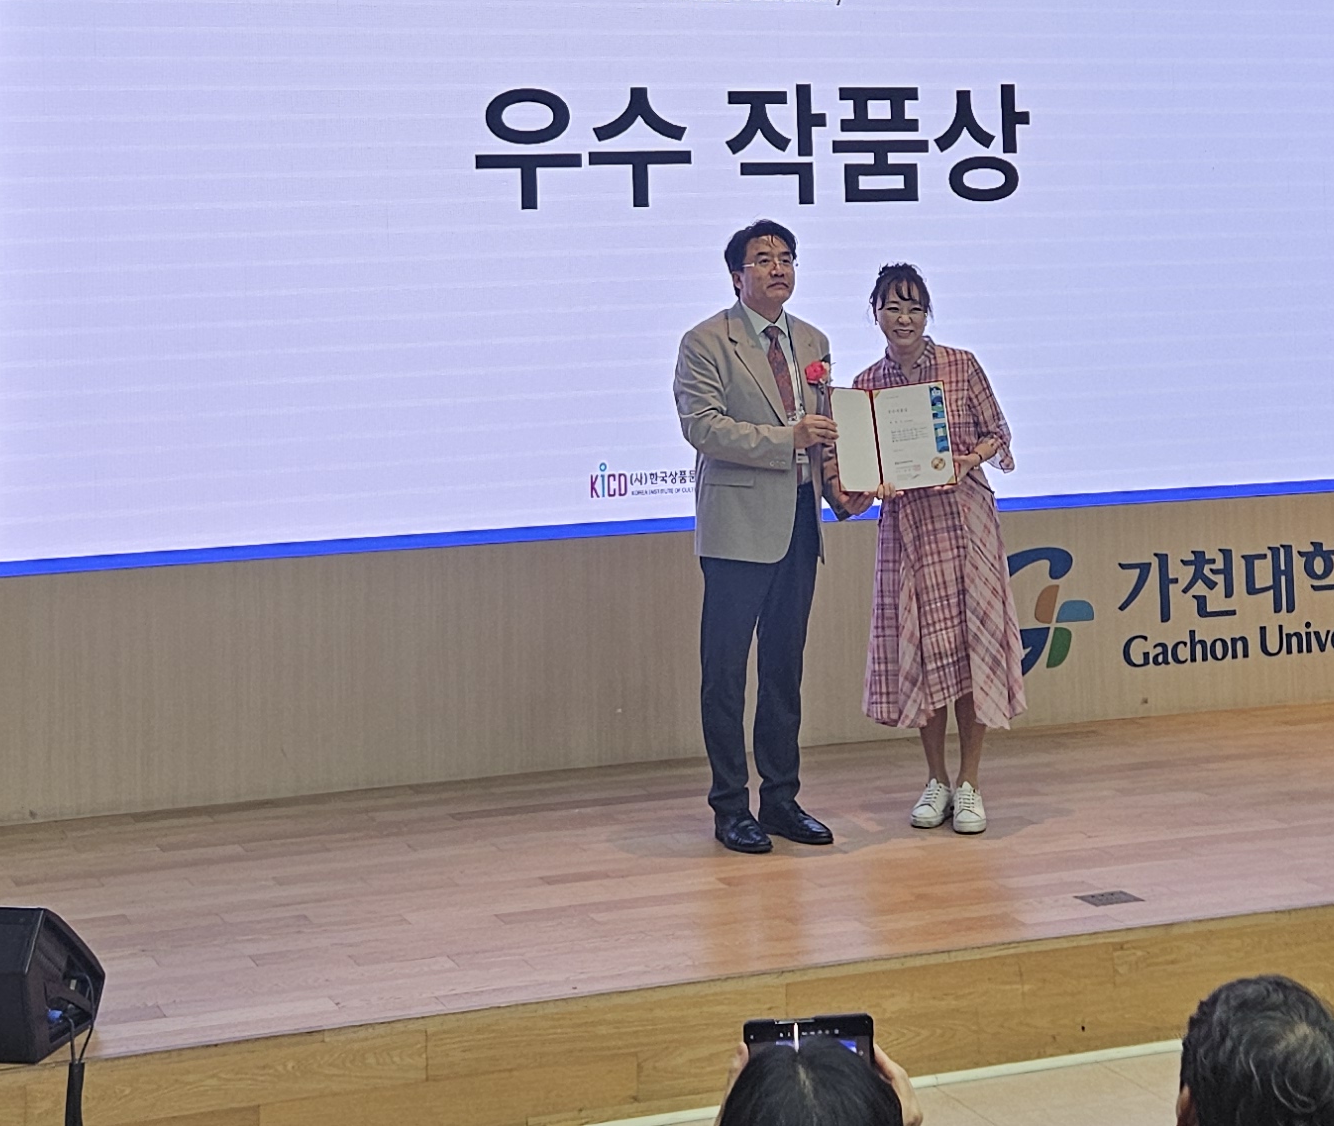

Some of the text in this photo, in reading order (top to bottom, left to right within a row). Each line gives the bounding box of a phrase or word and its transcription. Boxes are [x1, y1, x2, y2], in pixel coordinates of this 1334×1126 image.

[475, 82, 1031, 210] 우수 작품상
[1122, 627, 1249, 668] Gachon
